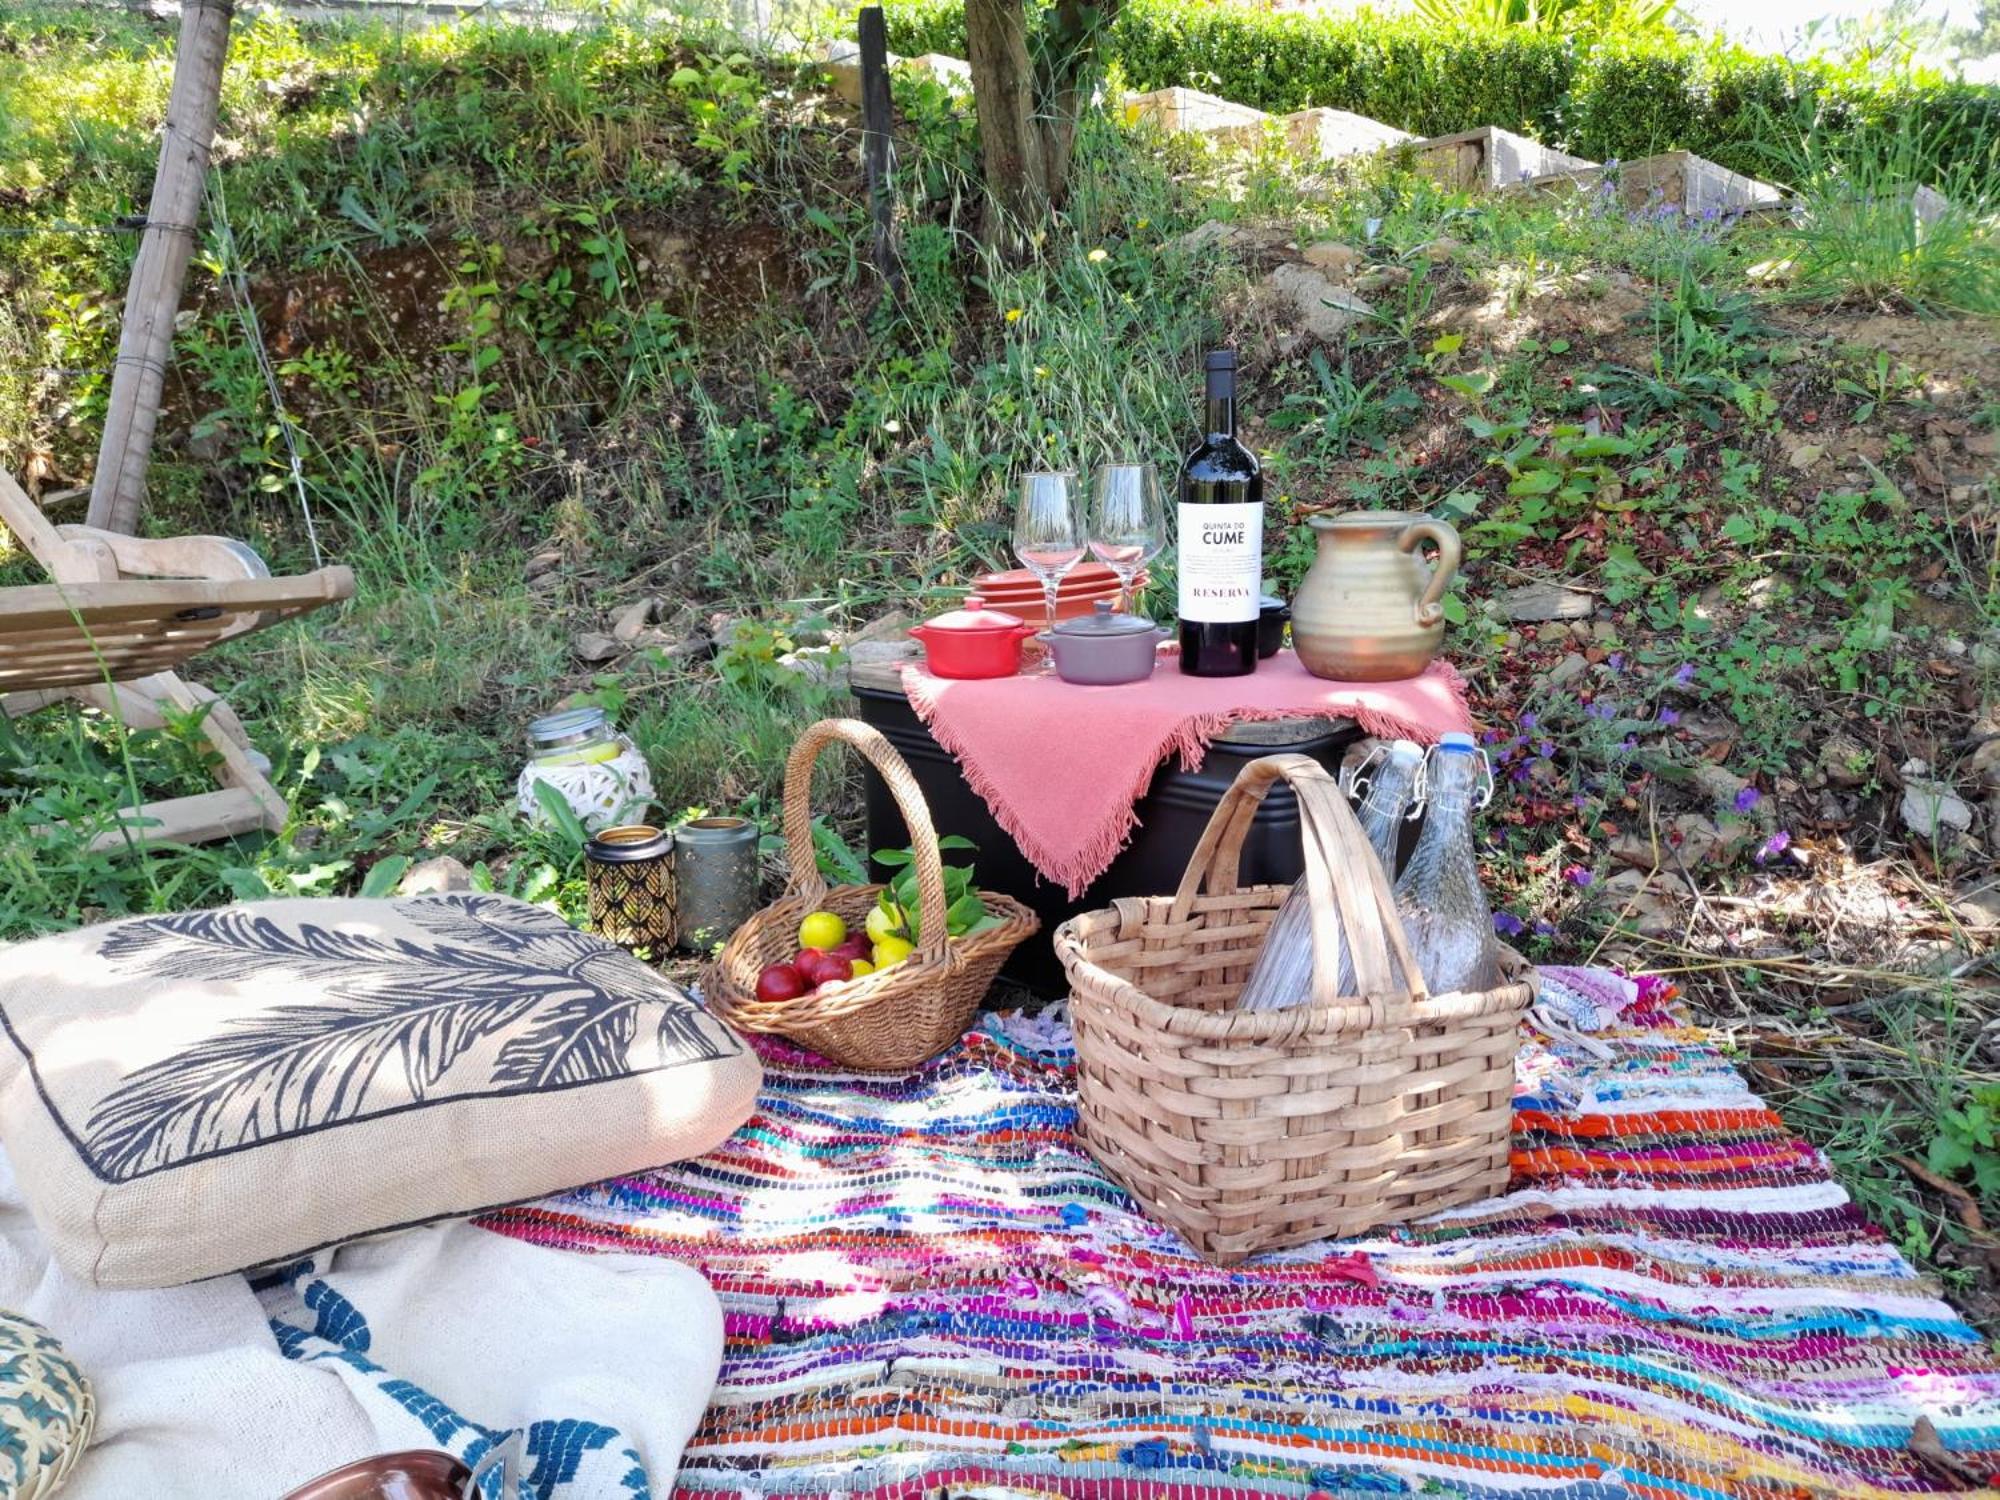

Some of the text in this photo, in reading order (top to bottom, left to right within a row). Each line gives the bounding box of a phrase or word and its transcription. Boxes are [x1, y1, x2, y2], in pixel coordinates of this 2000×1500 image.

[1203, 522, 1245, 530] QUINTA DO
[1202, 531, 1245, 545] CUME
[1193, 588, 1250, 598] RESERVA
